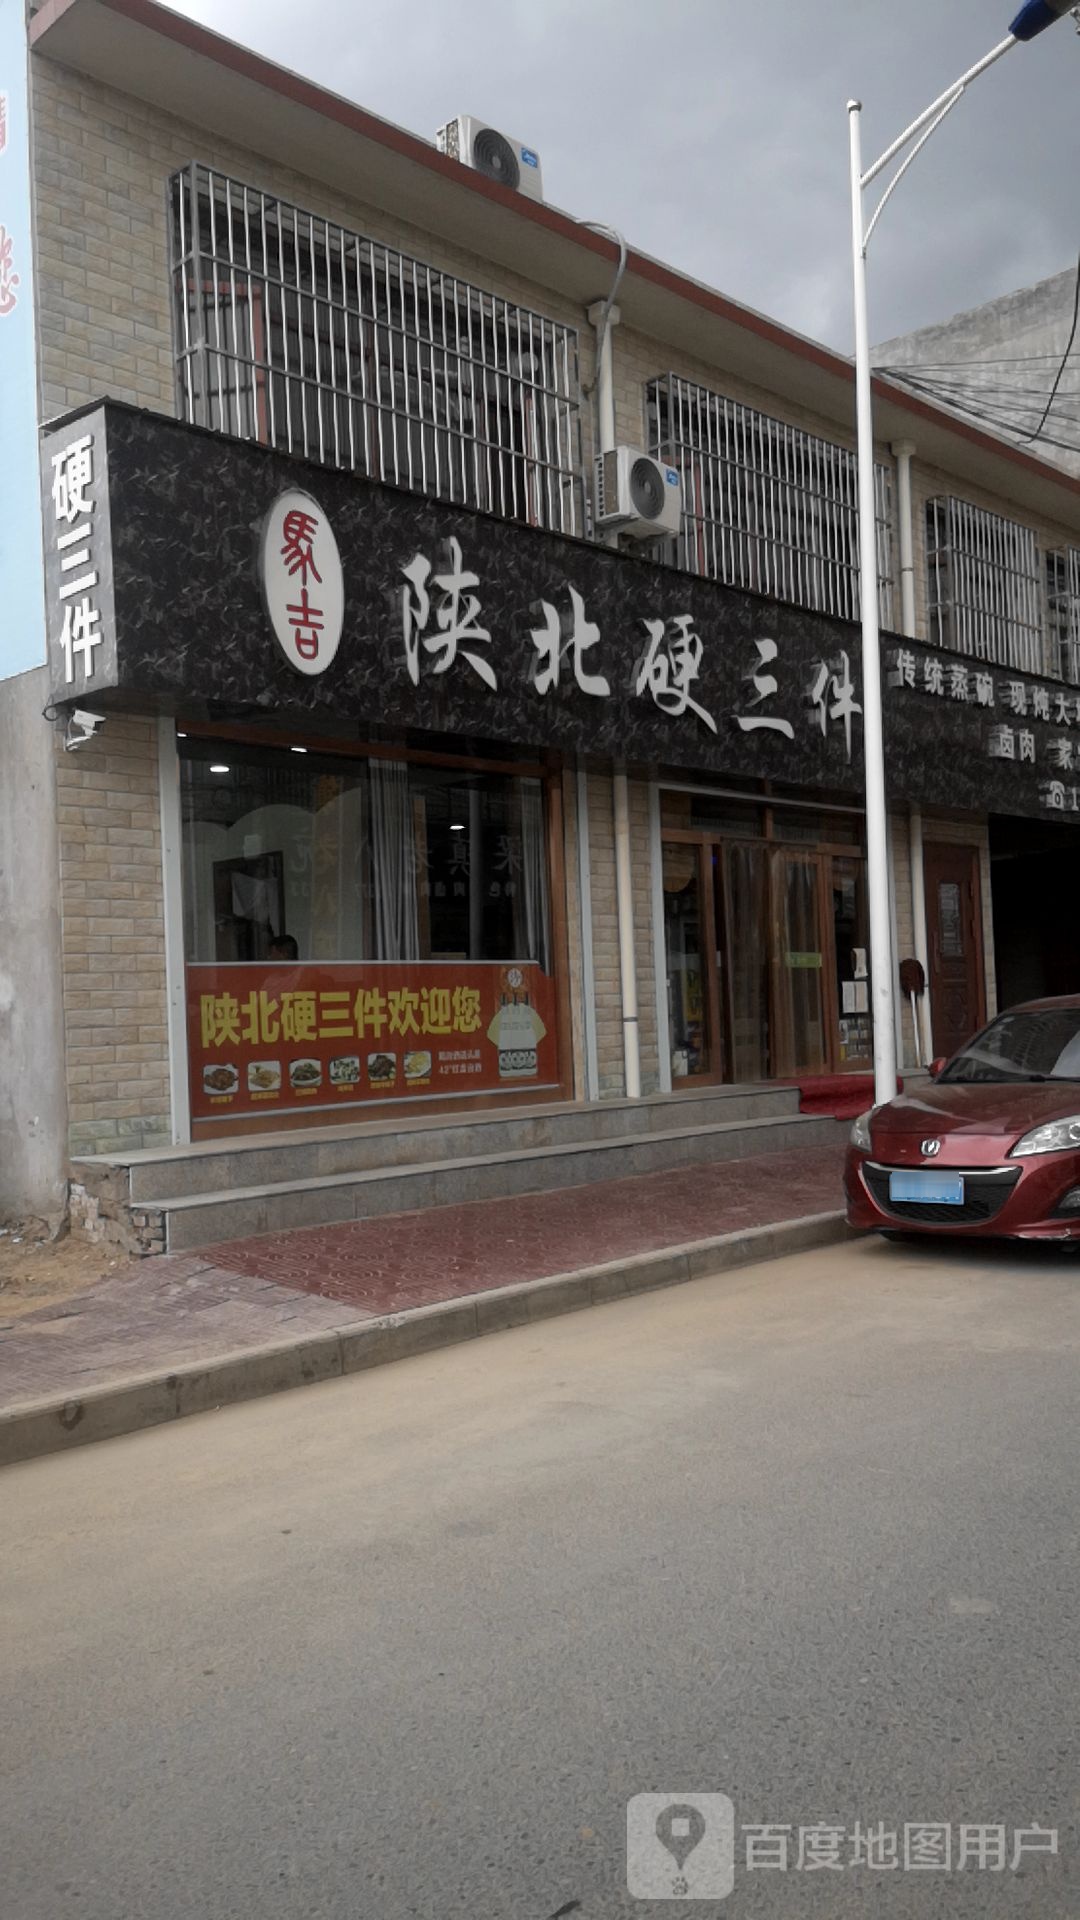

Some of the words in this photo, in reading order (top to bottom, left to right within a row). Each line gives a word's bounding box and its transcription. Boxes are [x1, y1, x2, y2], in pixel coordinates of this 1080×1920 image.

[51, 433, 102, 683] 硬三件
[400, 535, 863, 765] 陕北硬三件
[896, 648, 995, 707] 传统蒸碗
[1007, 680, 1080, 725] 现炖大
[200, 985, 482, 1048] 陕北硬三件欢迎您
